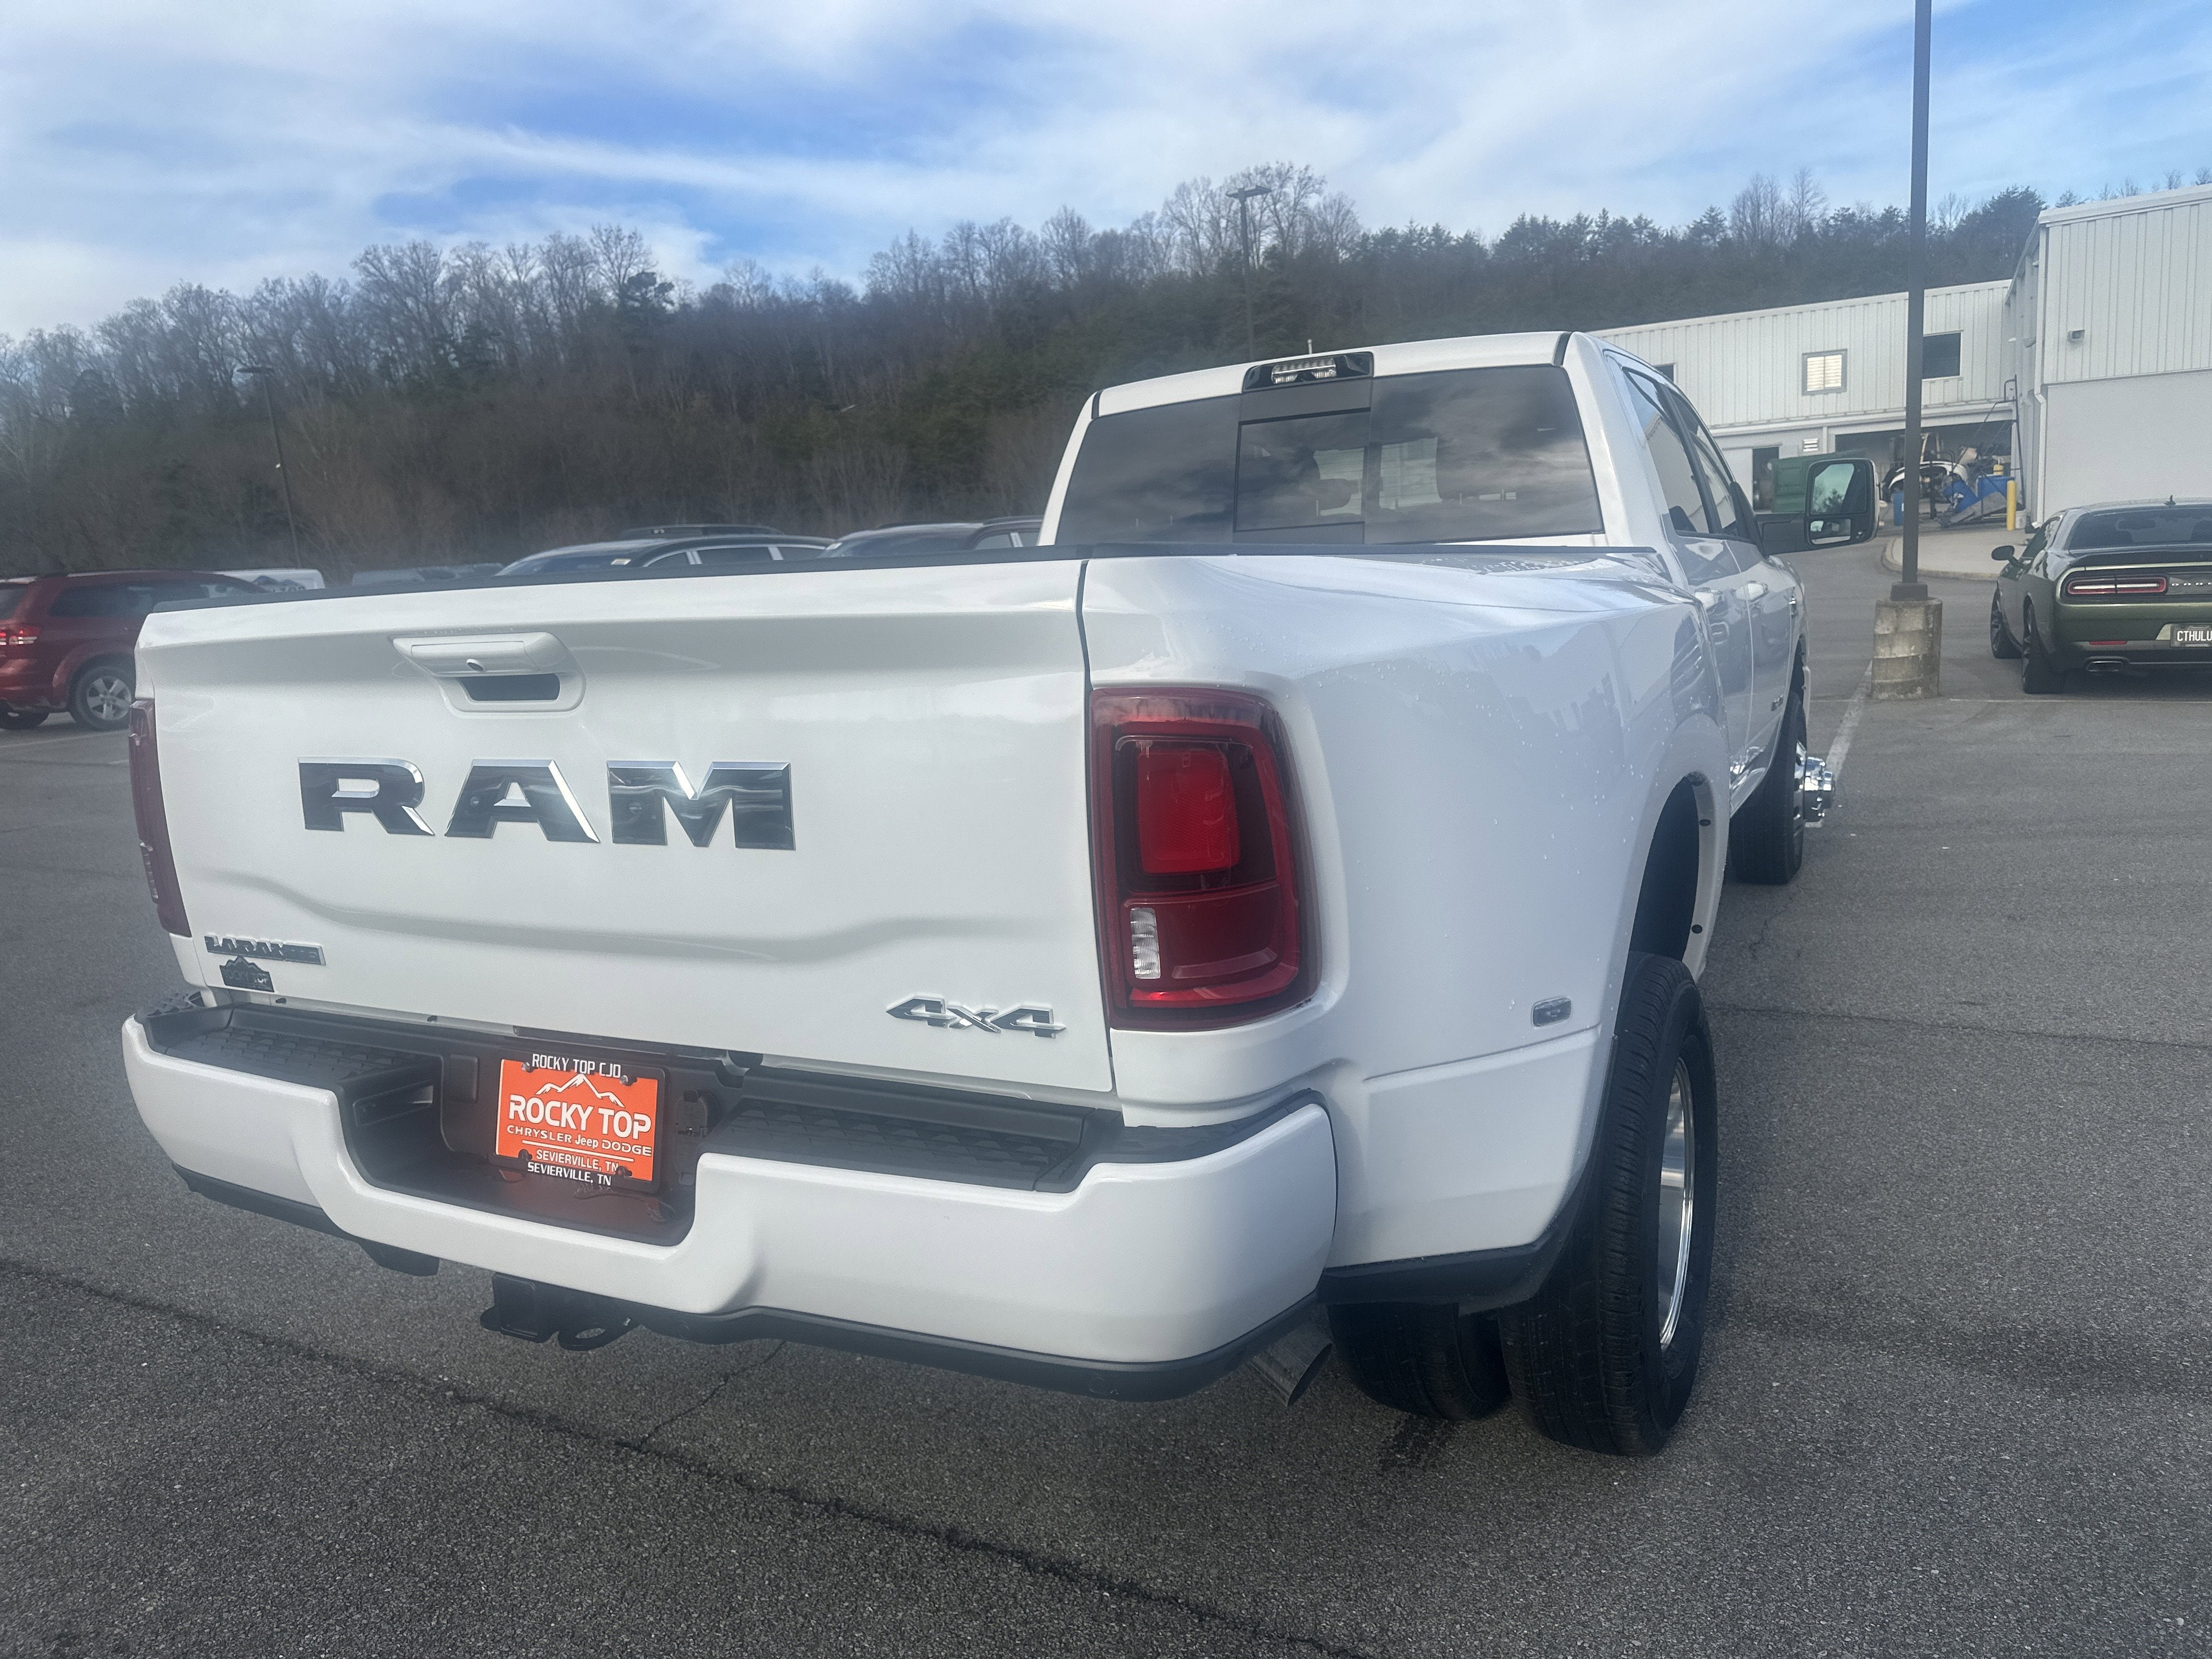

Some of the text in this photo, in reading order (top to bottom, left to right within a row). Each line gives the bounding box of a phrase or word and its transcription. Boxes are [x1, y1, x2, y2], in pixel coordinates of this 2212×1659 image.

[2176, 630, 2212, 642] CTHULU
[297, 756, 796, 851] RAM
[532, 1053, 622, 1078] ROCKY TOP CJD
[508, 1094, 652, 1140] ROCKY TOP
[507, 1125, 652, 1156] CHRYSLER Jeep DODGE
[536, 1149, 619, 1172] SEVIERVILLE, TN
[527, 1161, 612, 1186] SEVIERVILLE, TN
